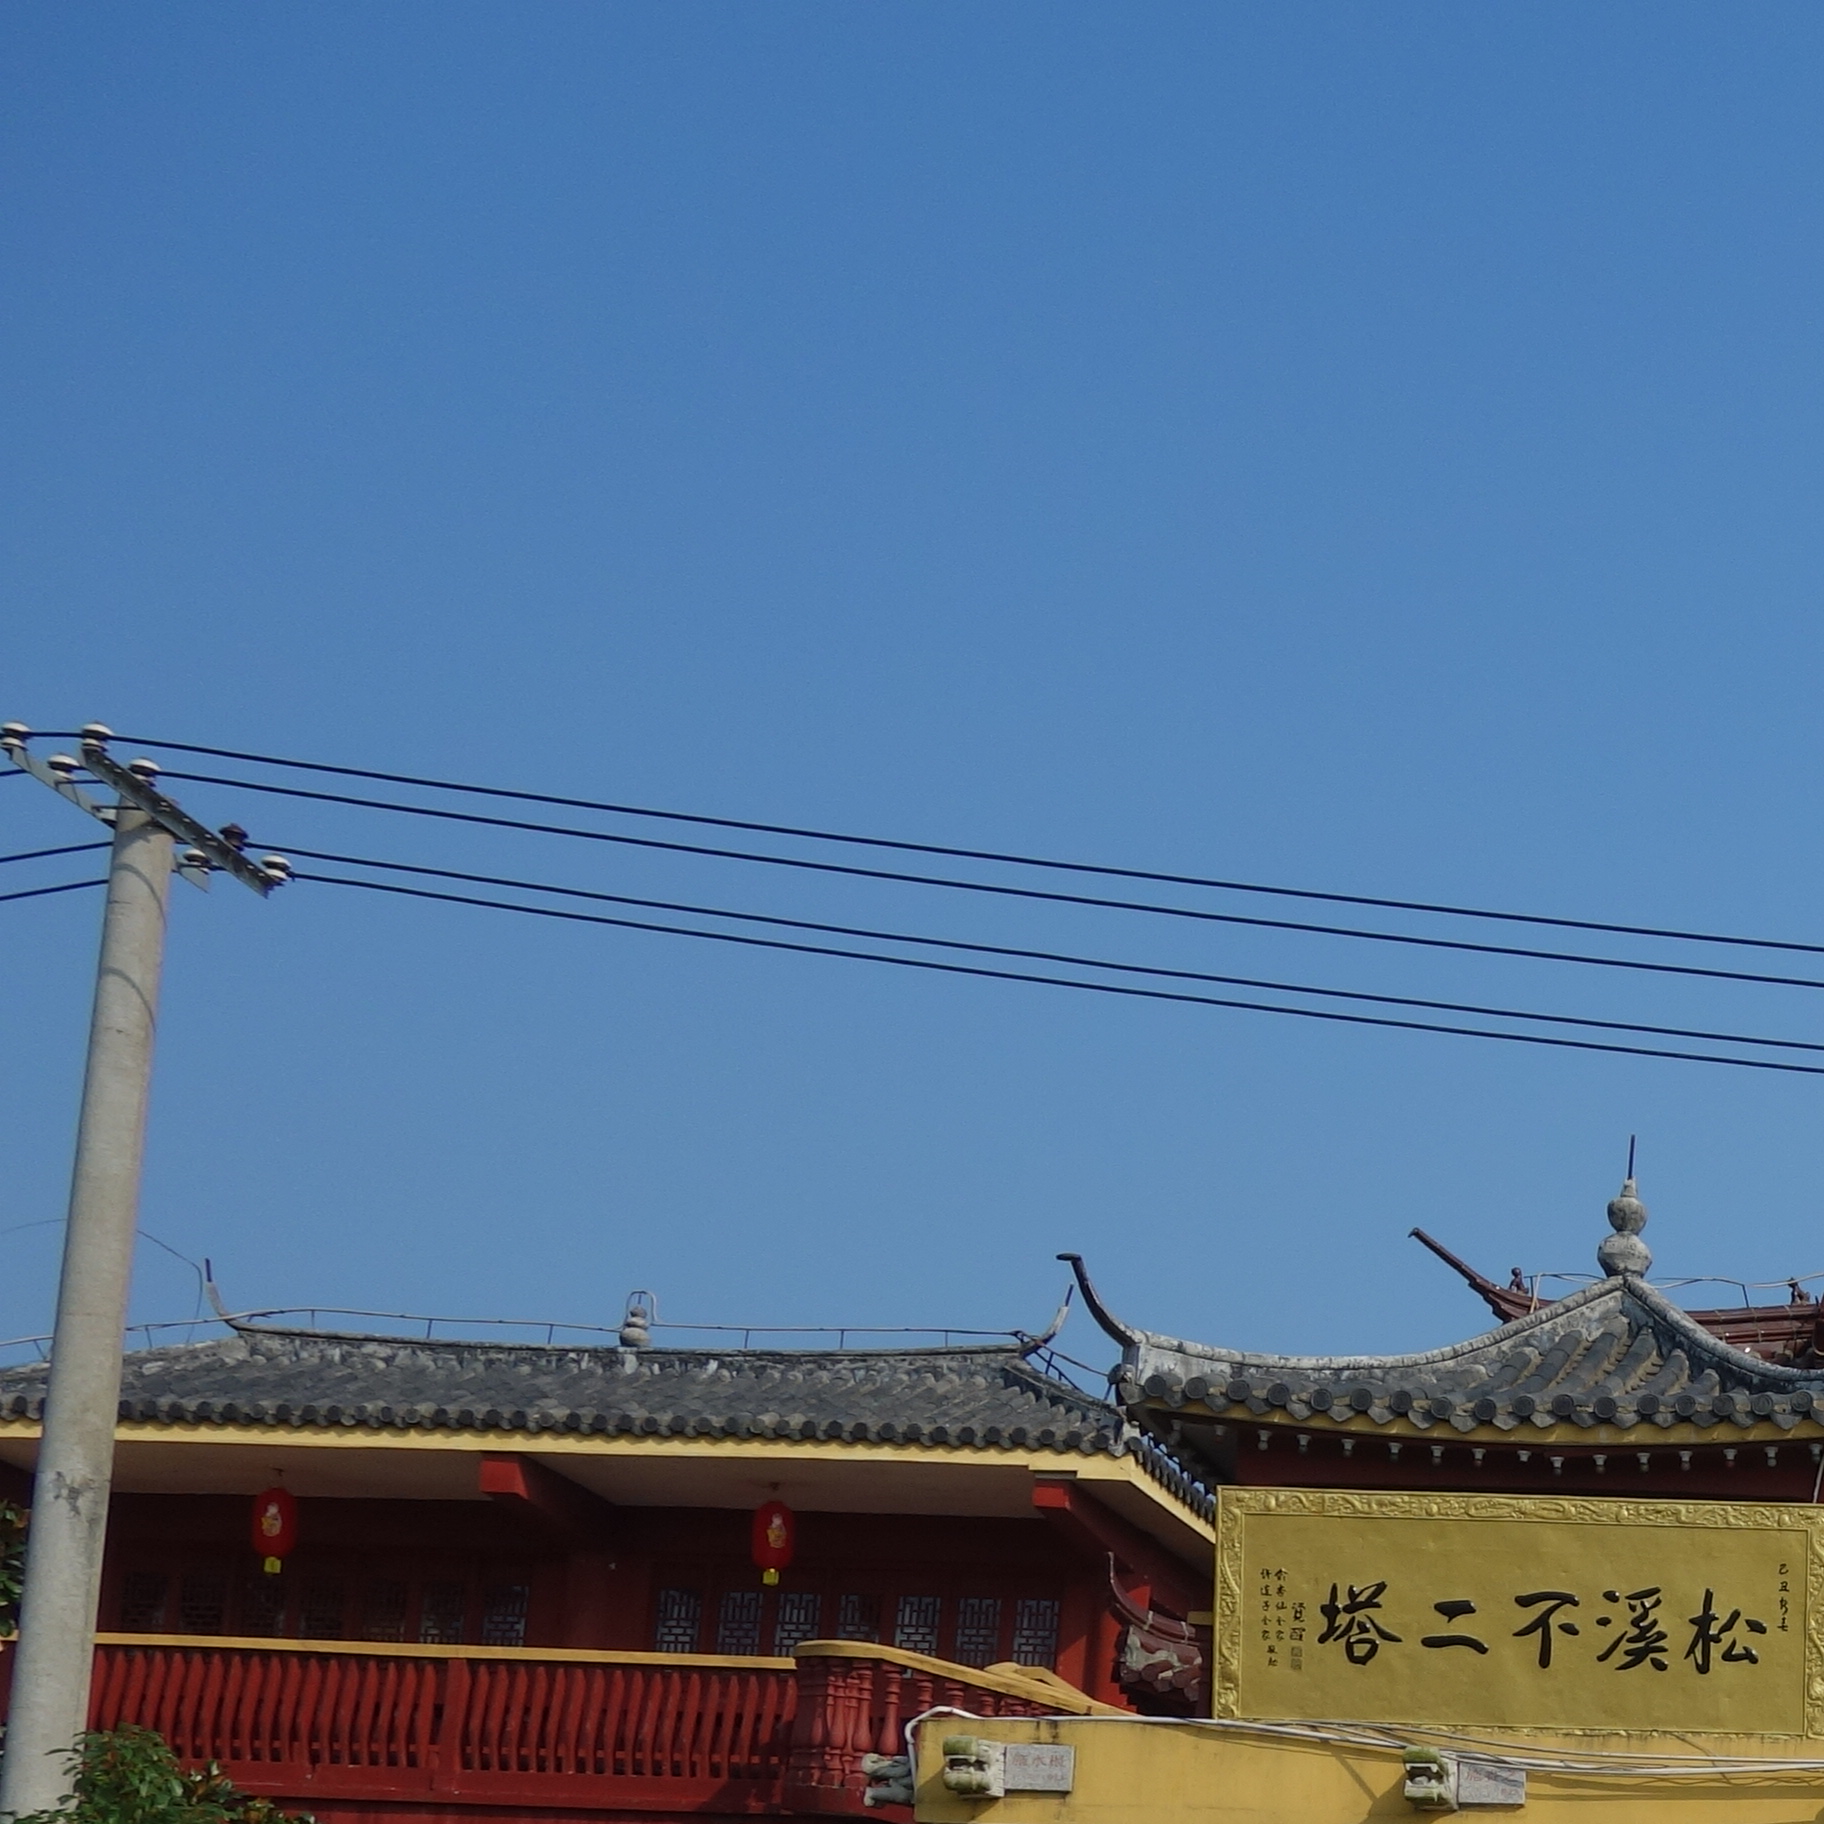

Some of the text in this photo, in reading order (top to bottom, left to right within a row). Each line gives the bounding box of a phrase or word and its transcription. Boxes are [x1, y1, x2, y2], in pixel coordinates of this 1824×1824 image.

[1317, 1580, 1767, 1675] 松溪不二塔
